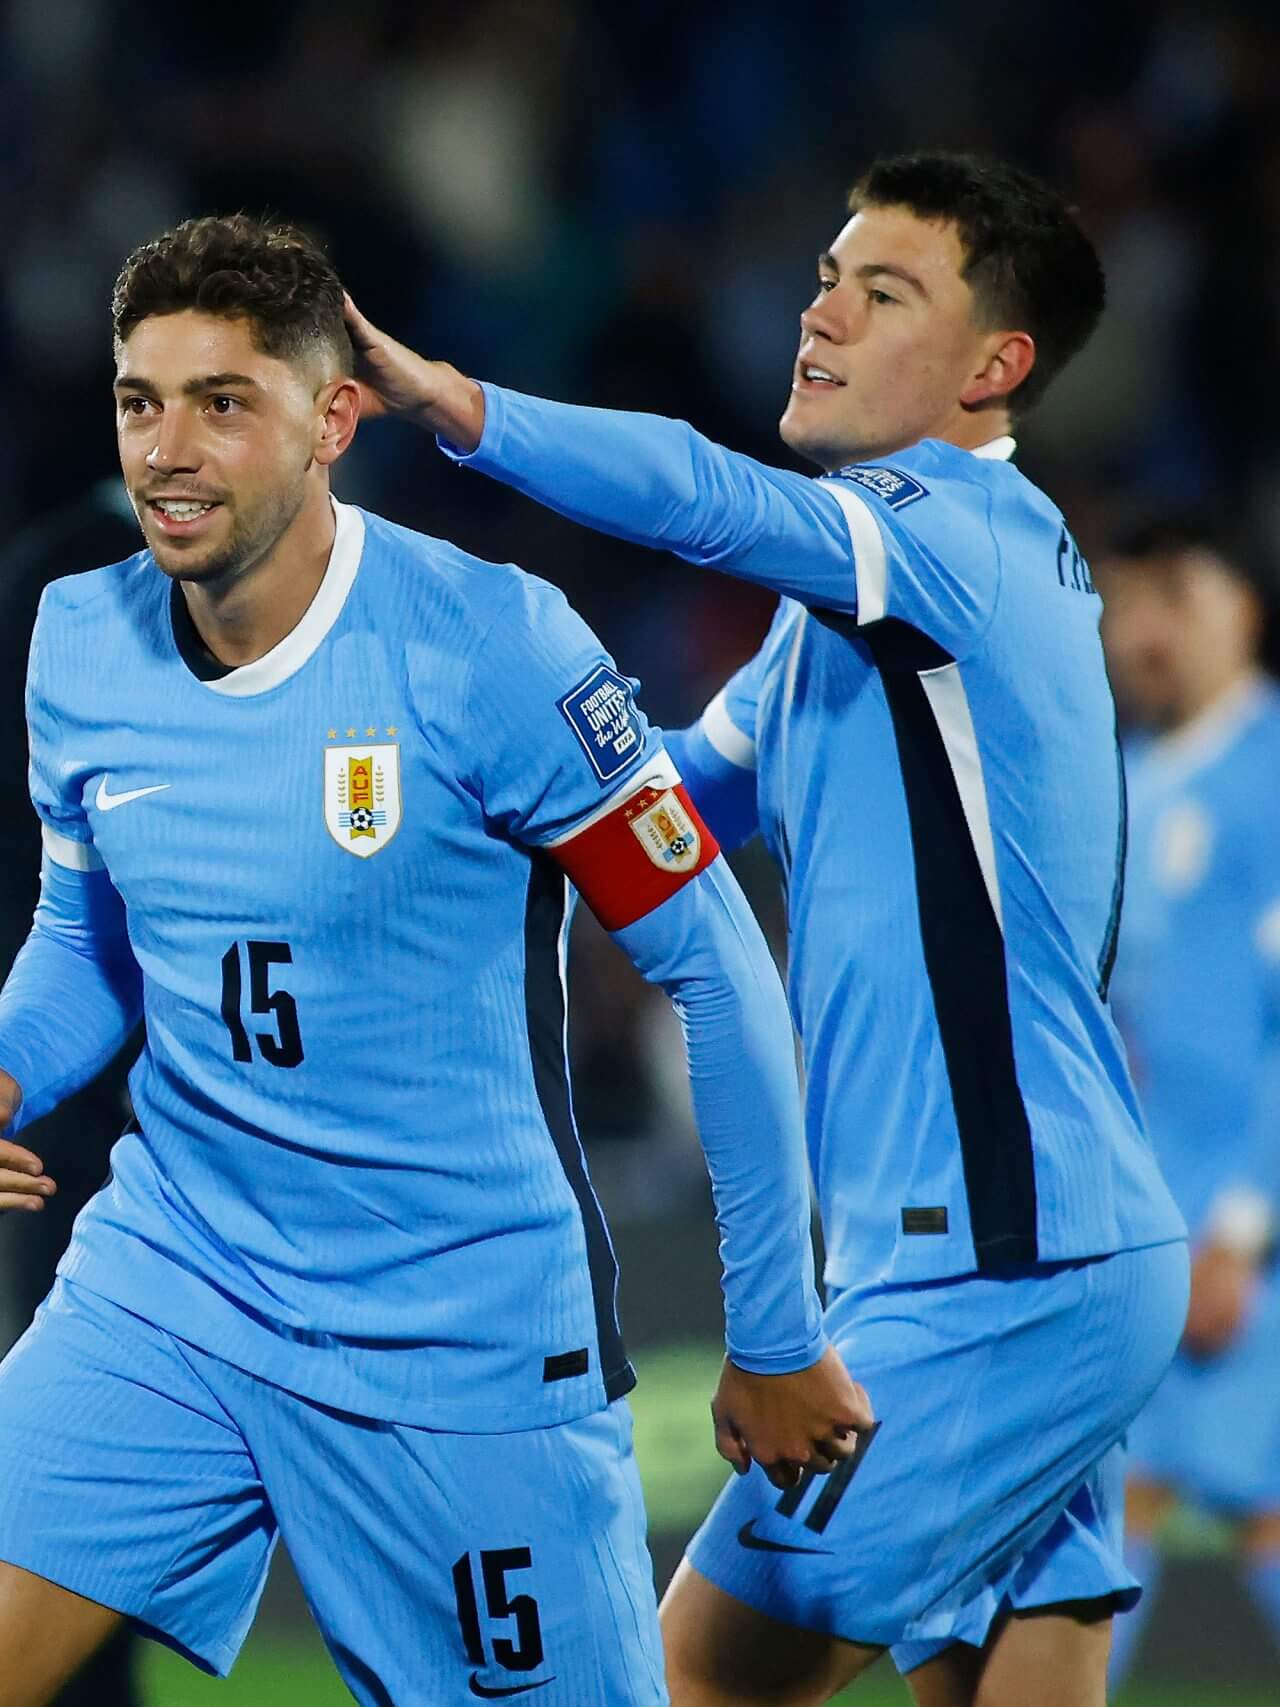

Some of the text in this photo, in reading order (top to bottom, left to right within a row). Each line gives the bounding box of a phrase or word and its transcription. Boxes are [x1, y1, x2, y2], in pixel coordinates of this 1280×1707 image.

[580, 680, 619, 716] FOOTBALL
[595, 730, 614, 748] the
[352, 765, 370, 804] AUF
[221, 940, 305, 1068] 15
[452, 1546, 544, 1671] 15
